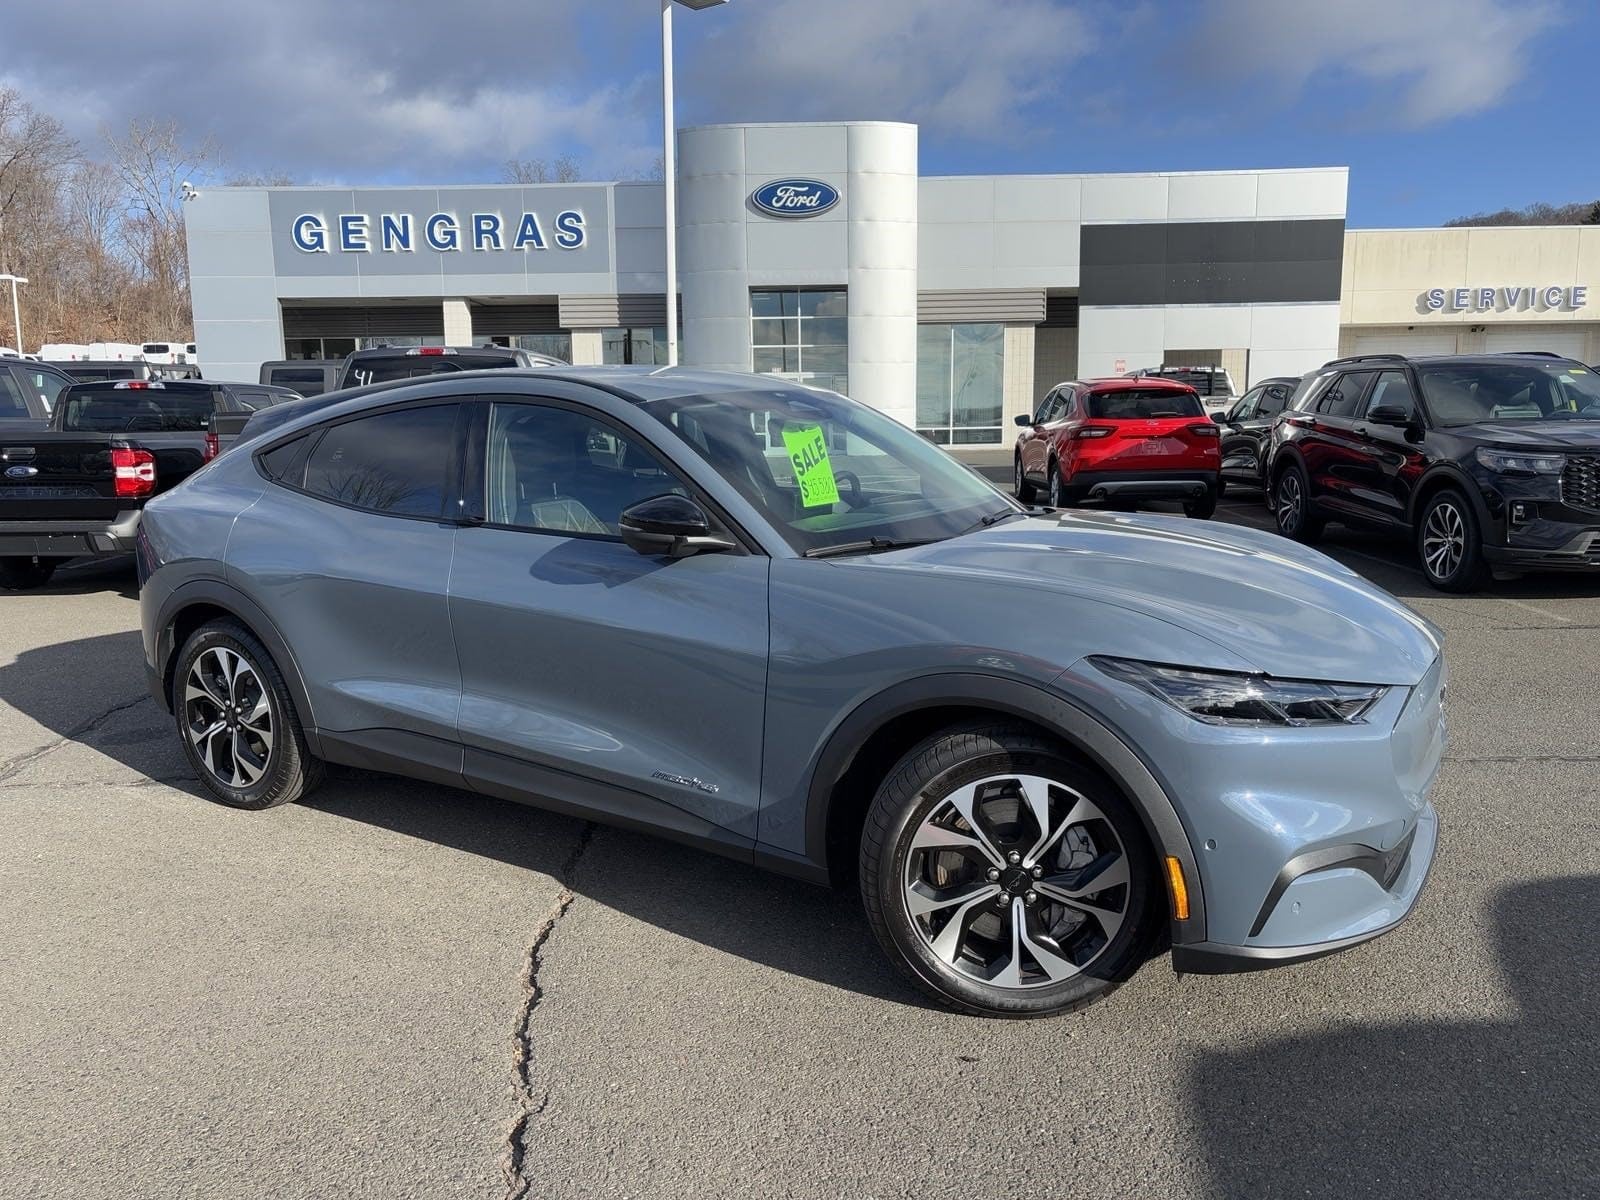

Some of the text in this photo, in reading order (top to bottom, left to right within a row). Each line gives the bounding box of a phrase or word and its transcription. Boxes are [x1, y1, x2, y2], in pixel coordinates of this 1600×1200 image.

[772, 186, 821, 208] Ford
[292, 211, 586, 252] GENGRAS
[1428, 286, 1588, 309] SERVICE
[792, 435, 827, 477] SALE
